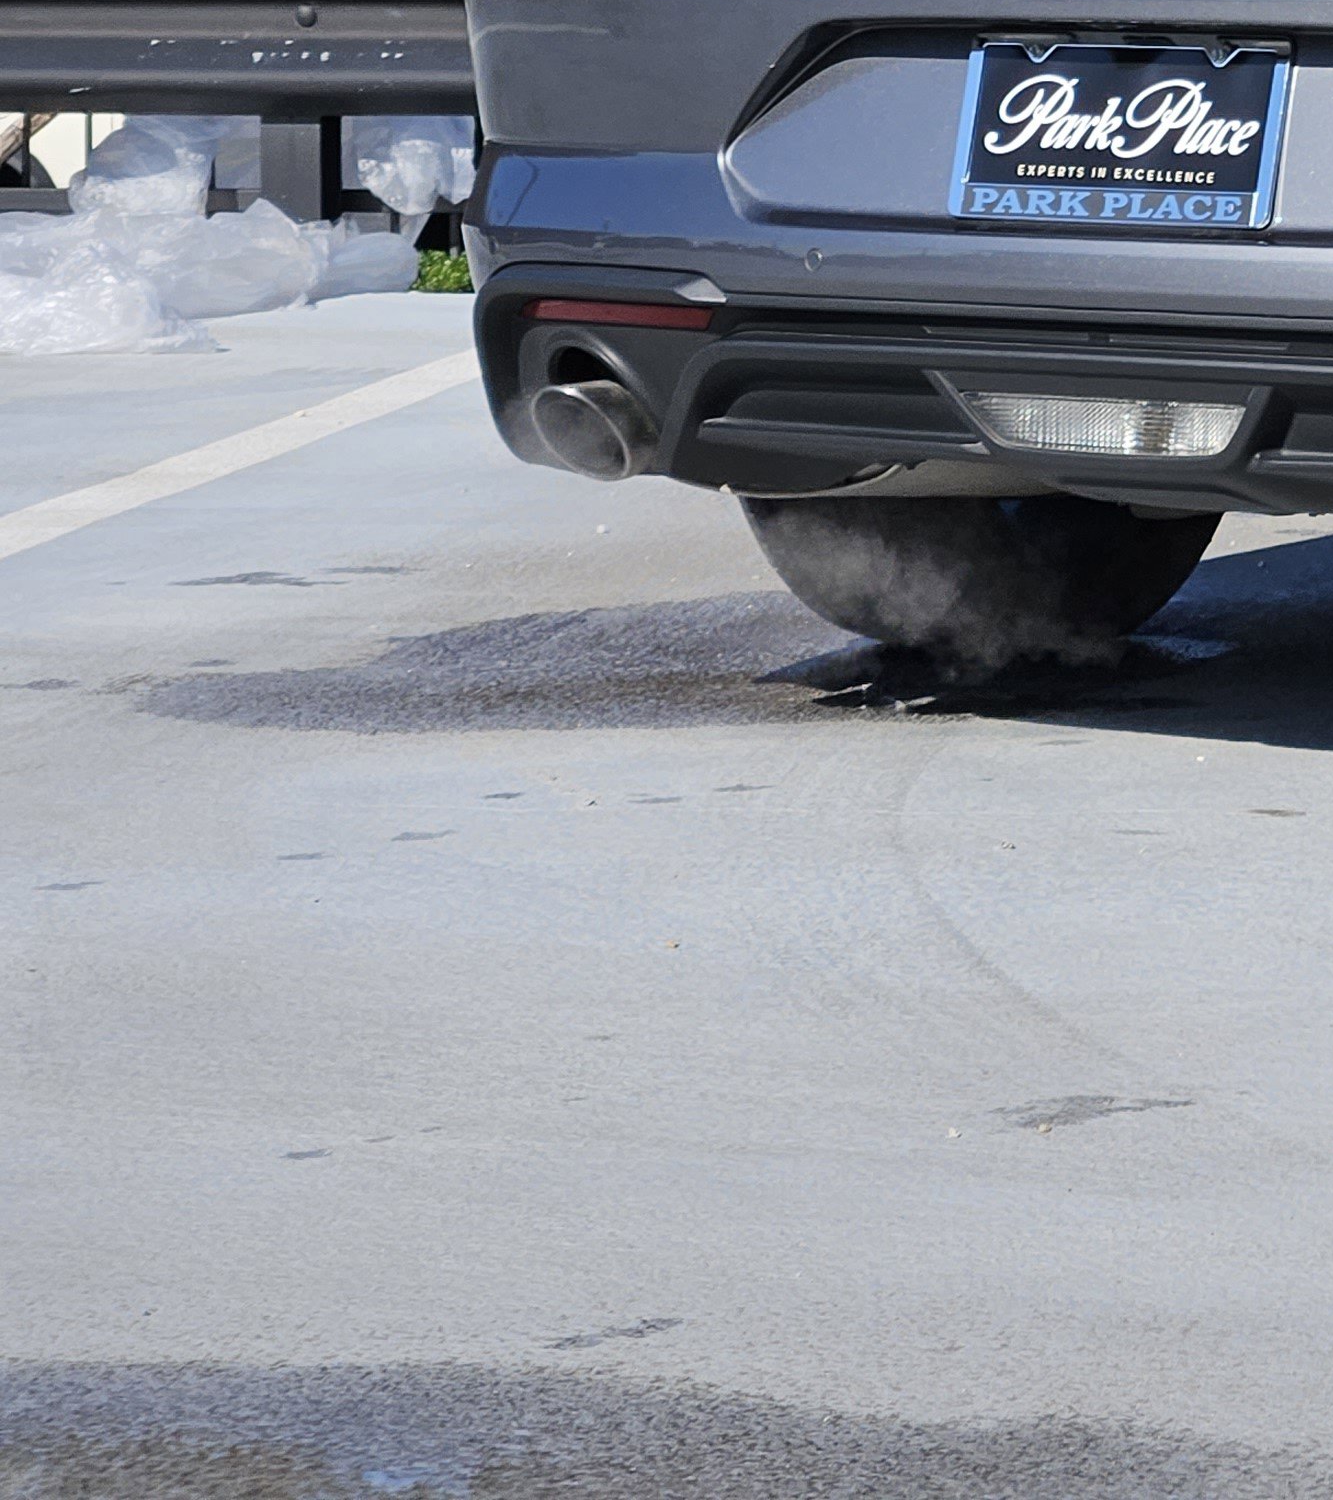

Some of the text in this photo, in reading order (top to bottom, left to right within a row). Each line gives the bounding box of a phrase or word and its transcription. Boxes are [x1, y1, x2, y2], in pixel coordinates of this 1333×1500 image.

[984, 74, 1260, 158] Park Place
[1016, 164, 1215, 184] EXPERTS IN EXCELLENCE
[970, 187, 1243, 222] PARK PLACE
